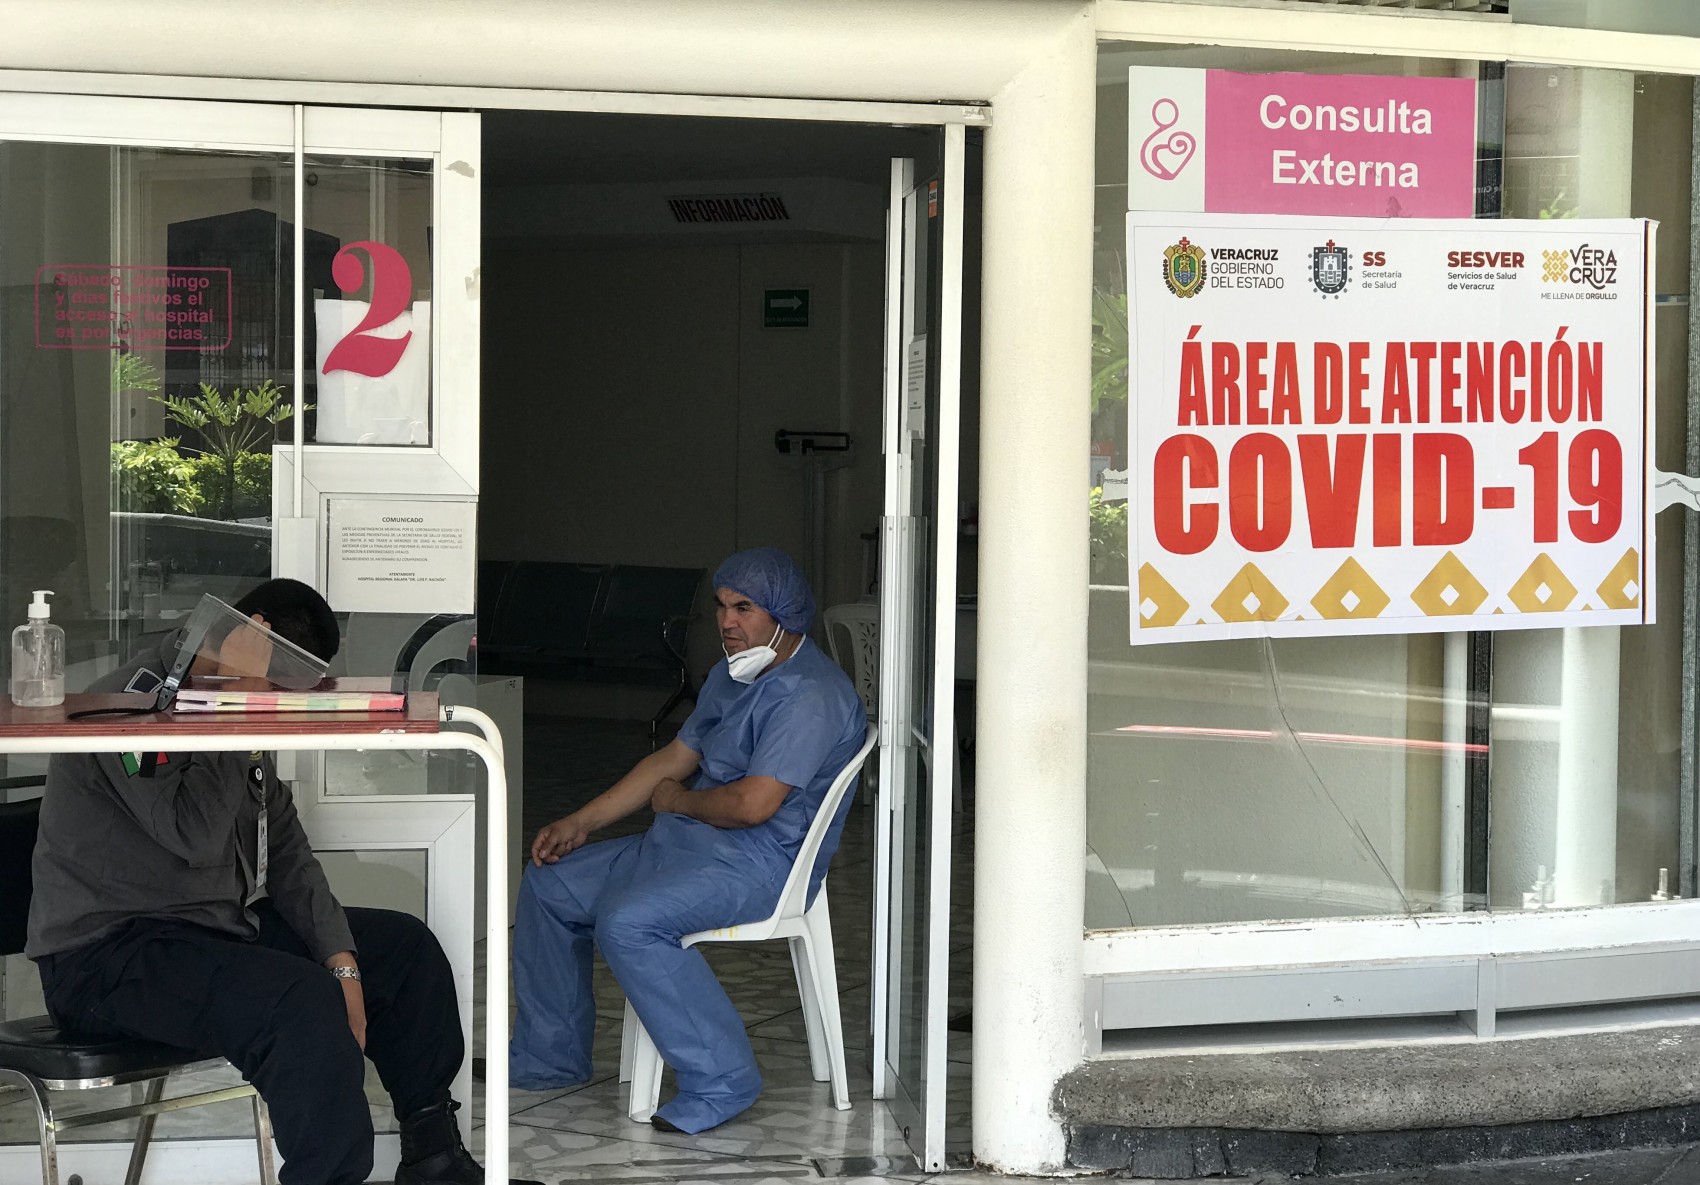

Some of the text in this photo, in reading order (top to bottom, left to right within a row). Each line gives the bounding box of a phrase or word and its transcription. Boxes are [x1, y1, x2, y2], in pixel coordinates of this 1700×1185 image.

[1259, 94, 1433, 135] Consulta
[1272, 149, 1419, 188] Externa
[667, 192, 792, 223] INFORMACIÓN
[1210, 248, 1278, 261] VERACRUZ
[1362, 252, 1386, 267] SS
[1447, 251, 1525, 268] SESVER
[1569, 244, 1618, 267] VERA
[1210, 262, 1274, 274] GOBIERNO
[1448, 272, 1517, 280] Servicios de Salud
[133, 272, 210, 292] domingo
[1211, 276, 1284, 289] DEL ESTADO
[1460, 282, 1495, 290] Veracruz
[1569, 268, 1617, 291] CRUZ
[55, 291, 66, 306] y
[114, 290, 182, 305] festivos
[188, 290, 203, 306] el
[55, 307, 214, 325] acceso al hospital
[322, 241, 412, 379] 2
[55, 328, 76, 339] es
[82, 327, 110, 343] por
[1177, 325, 1603, 426] ÁREA DE ATENCIÓN
[1153, 429, 1623, 555] COVID-19
